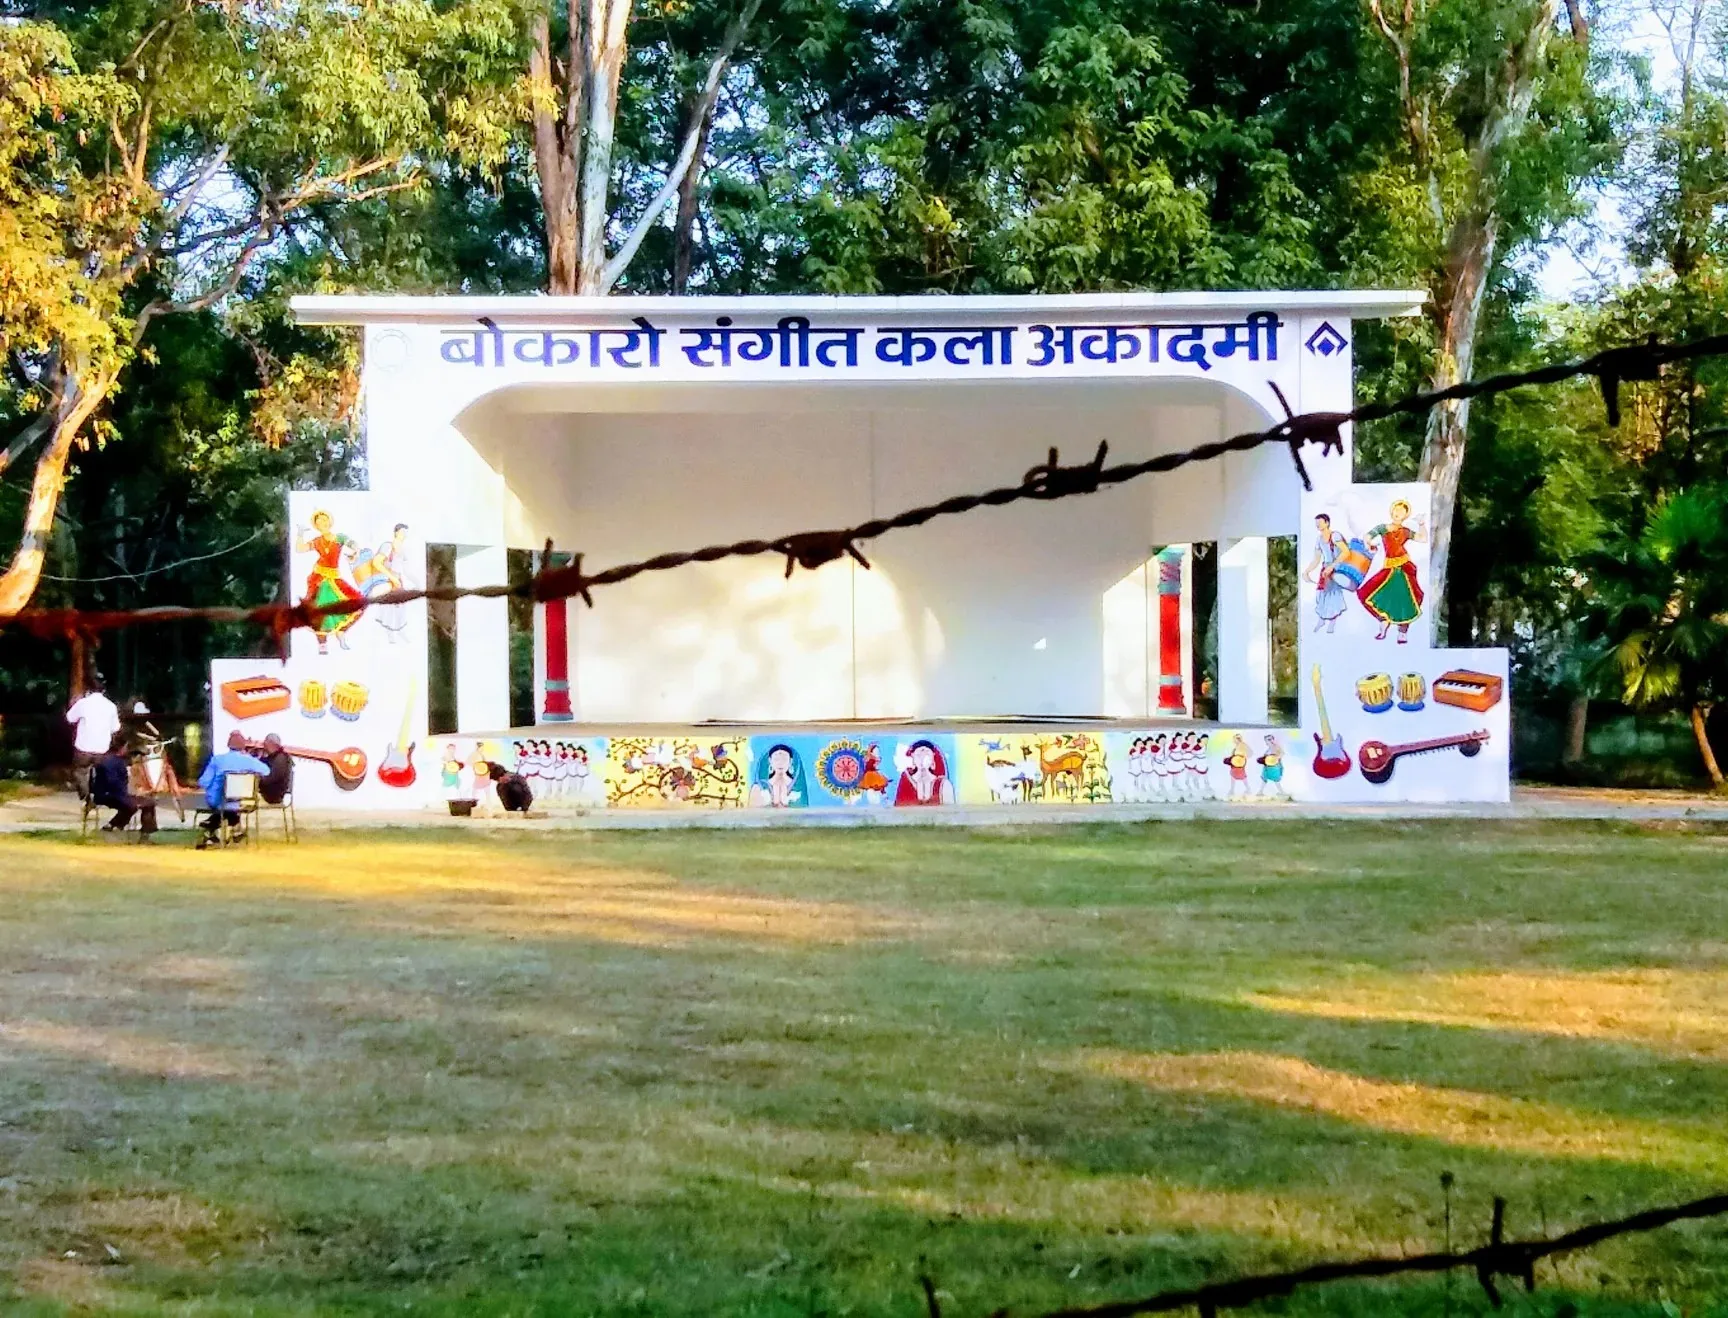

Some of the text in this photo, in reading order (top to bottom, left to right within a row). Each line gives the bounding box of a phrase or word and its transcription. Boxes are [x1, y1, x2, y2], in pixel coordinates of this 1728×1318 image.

[440, 311, 1284, 371] बोकारो संगीत कला अकादमी
